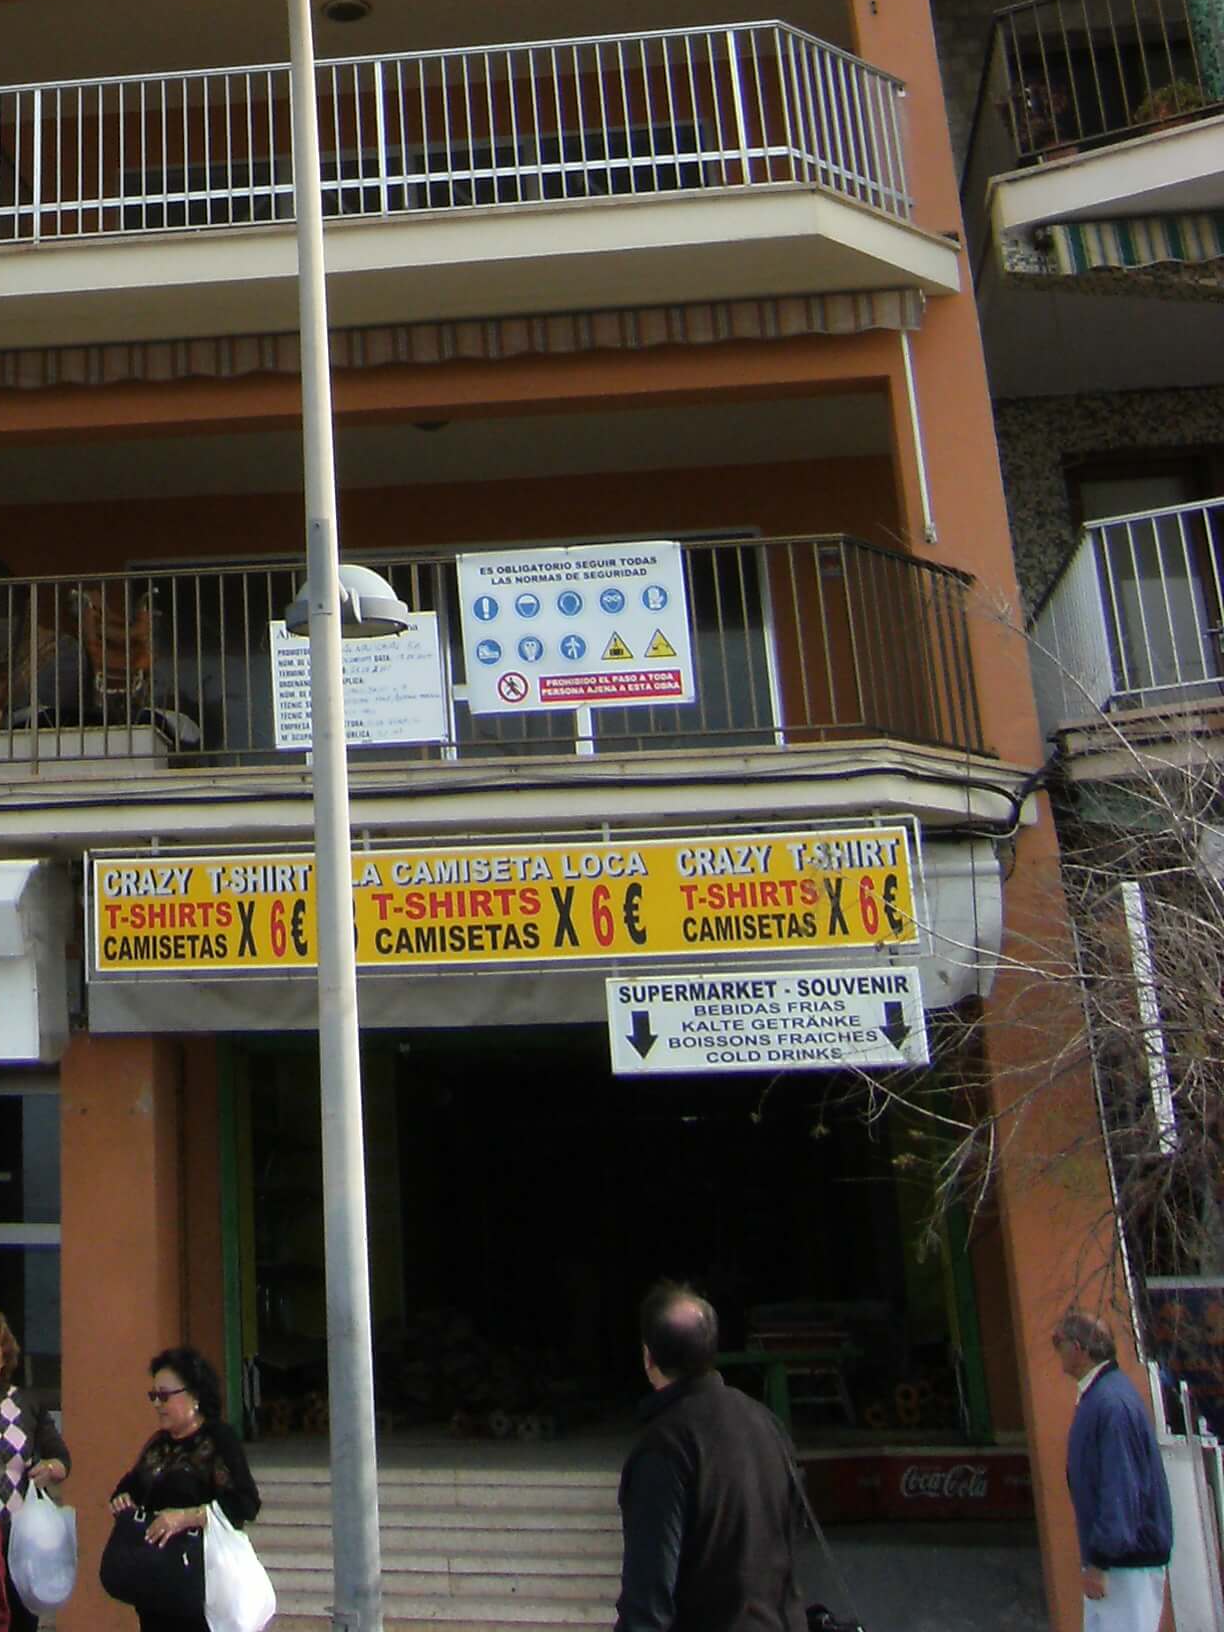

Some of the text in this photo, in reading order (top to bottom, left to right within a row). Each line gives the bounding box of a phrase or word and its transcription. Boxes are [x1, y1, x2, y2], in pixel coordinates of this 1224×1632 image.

[479, 555, 658, 576] ES OBLIGATORIO SEGUIR TODAS
[491, 567, 648, 586] LAS NORMAS DE SEGURIDAD
[598, 675, 611, 684] EL
[612, 674, 638, 683] PASO
[639, 673, 647, 681] A
[391, 855, 553, 887] CAMISETA
[563, 851, 649, 880] LOCA
[679, 838, 900, 878] CRAZY T-SHIRT
[103, 864, 313, 897] CRAZY T-SHIRT
[680, 878, 820, 911] T-SHIRTS
[105, 901, 233, 930] T-SHIRTS
[371, 887, 542, 921] T-SHIRTS
[551, 886, 580, 948] X
[824, 877, 849, 936] X
[237, 900, 257, 958] X
[375, 922, 541, 955] CAMISETAS
[682, 911, 817, 944] CAMISETAS
[103, 934, 228, 962] CAMISETAS
[618, 979, 777, 1004] SUPERMARKET
[797, 975, 910, 998] SOUVENIR
[681, 1014, 861, 1034] KALTE GETRÄNKE
[693, 999, 845, 1018] BEBIDAS FRIAS
[668, 1030, 878, 1050] BOISSONS FRAICHES
[706, 1047, 842, 1065] COLD DRINKS
